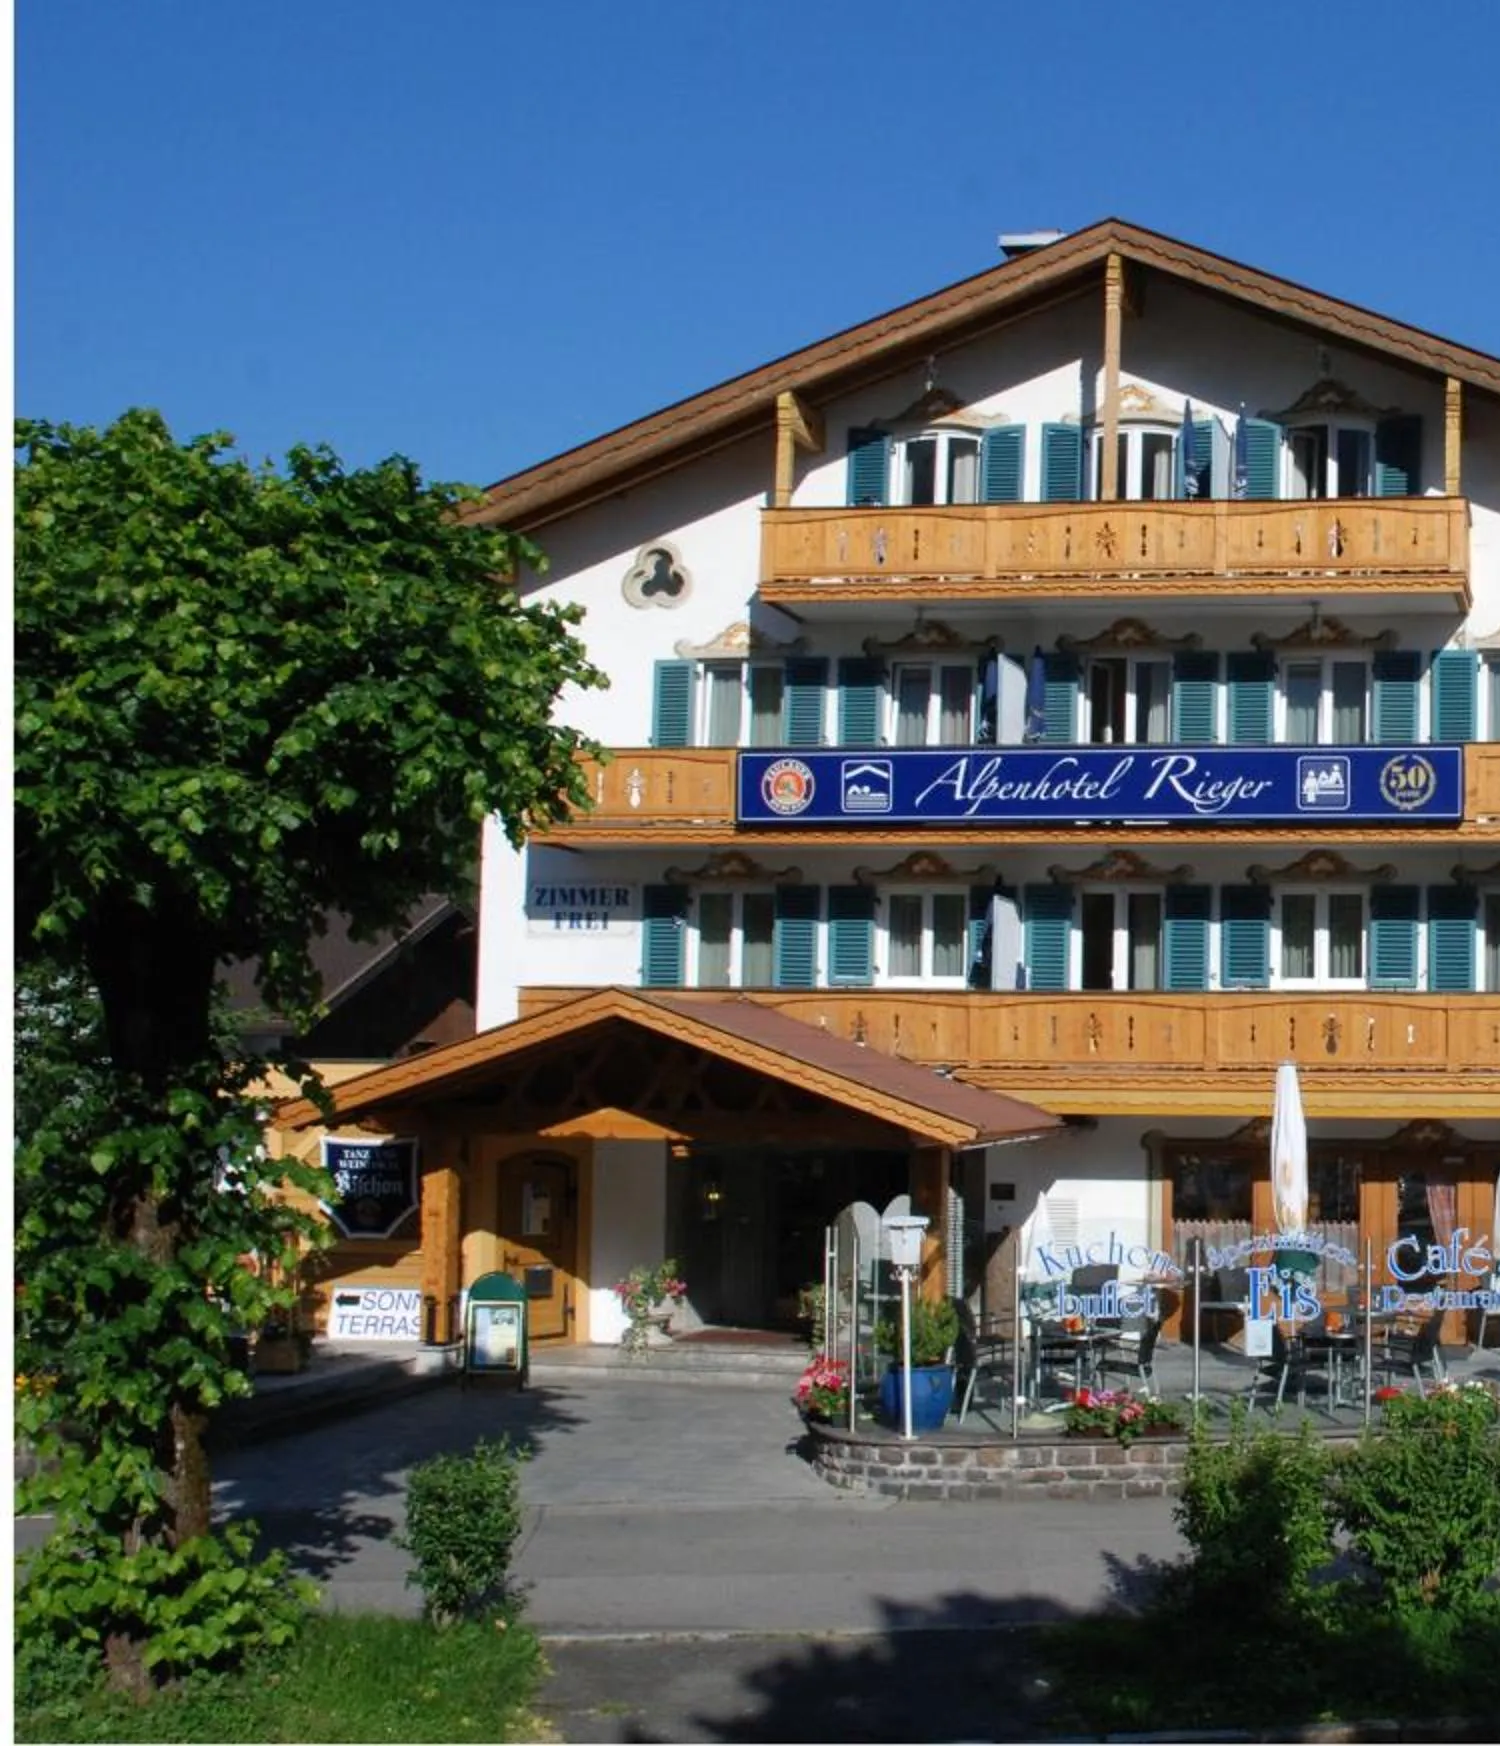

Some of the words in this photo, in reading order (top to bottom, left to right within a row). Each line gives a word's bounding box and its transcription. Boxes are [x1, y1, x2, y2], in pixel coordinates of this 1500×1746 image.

[915, 755, 1135, 815] Alpenhotel
[1144, 755, 1272, 813] Rieger
[1389, 765, 1427, 791] 50
[534, 886, 630, 907] ZIMMER
[554, 911, 609, 930] FREI
[1056, 1279, 1160, 1320] buffet
[1244, 1264, 1321, 1322] Eis
